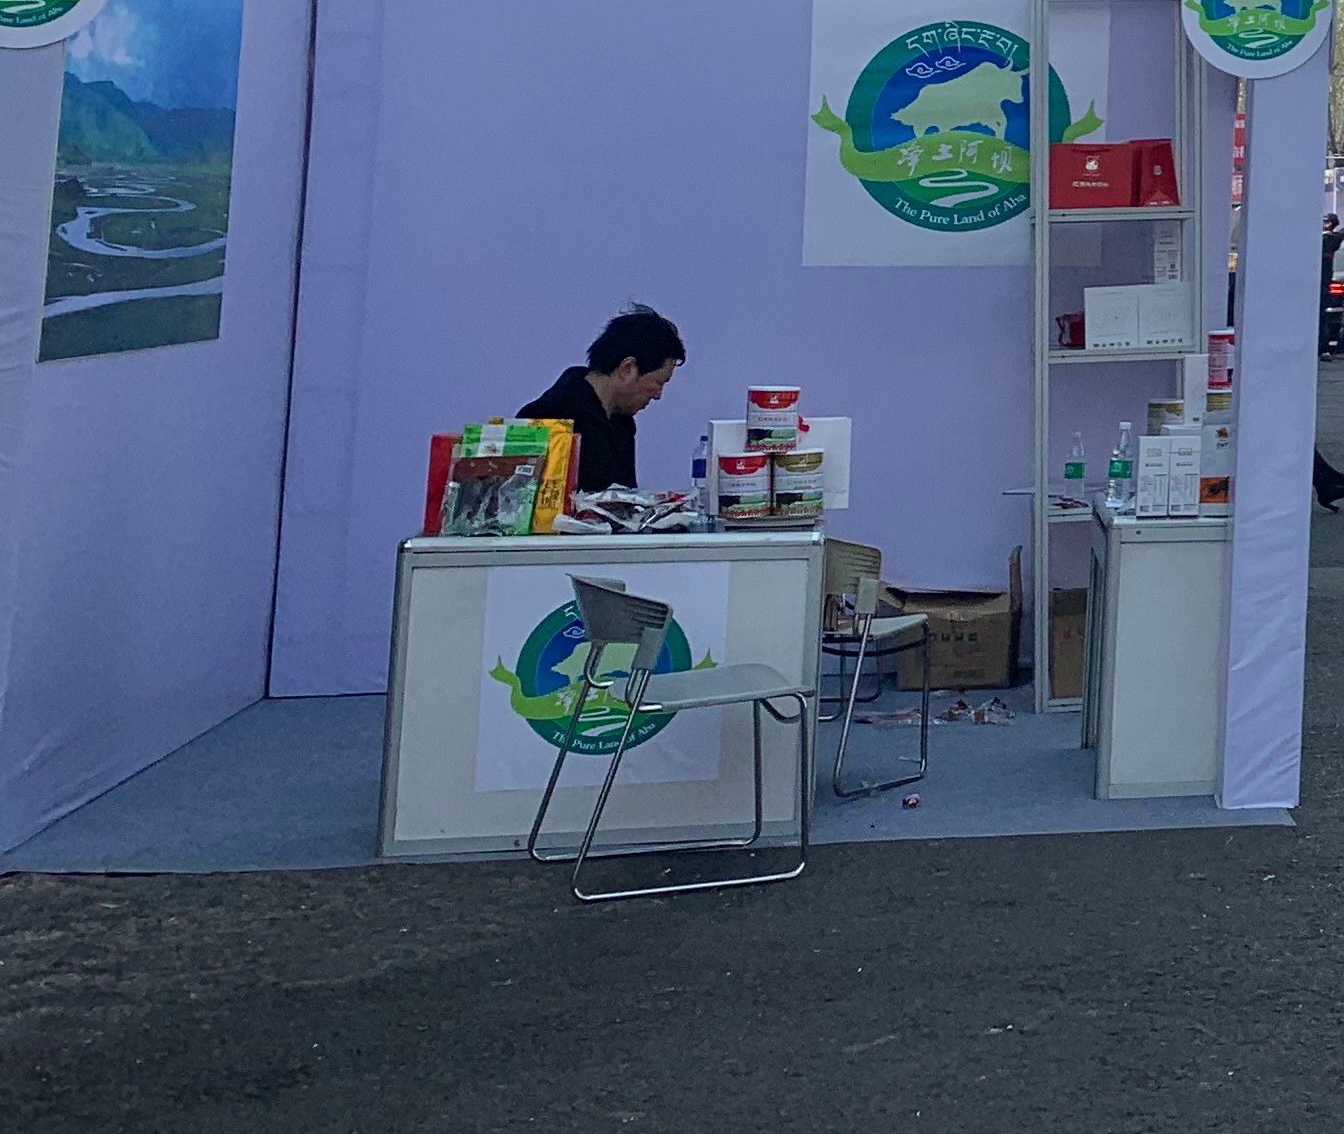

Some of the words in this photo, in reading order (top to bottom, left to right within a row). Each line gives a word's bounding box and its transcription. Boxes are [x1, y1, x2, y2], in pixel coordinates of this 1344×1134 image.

[894, 197, 918, 217] The
[919, 209, 950, 225] Pure
[952, 210, 985, 225] Land
[988, 204, 1002, 218] of
[1003, 194, 1027, 212] Aba
